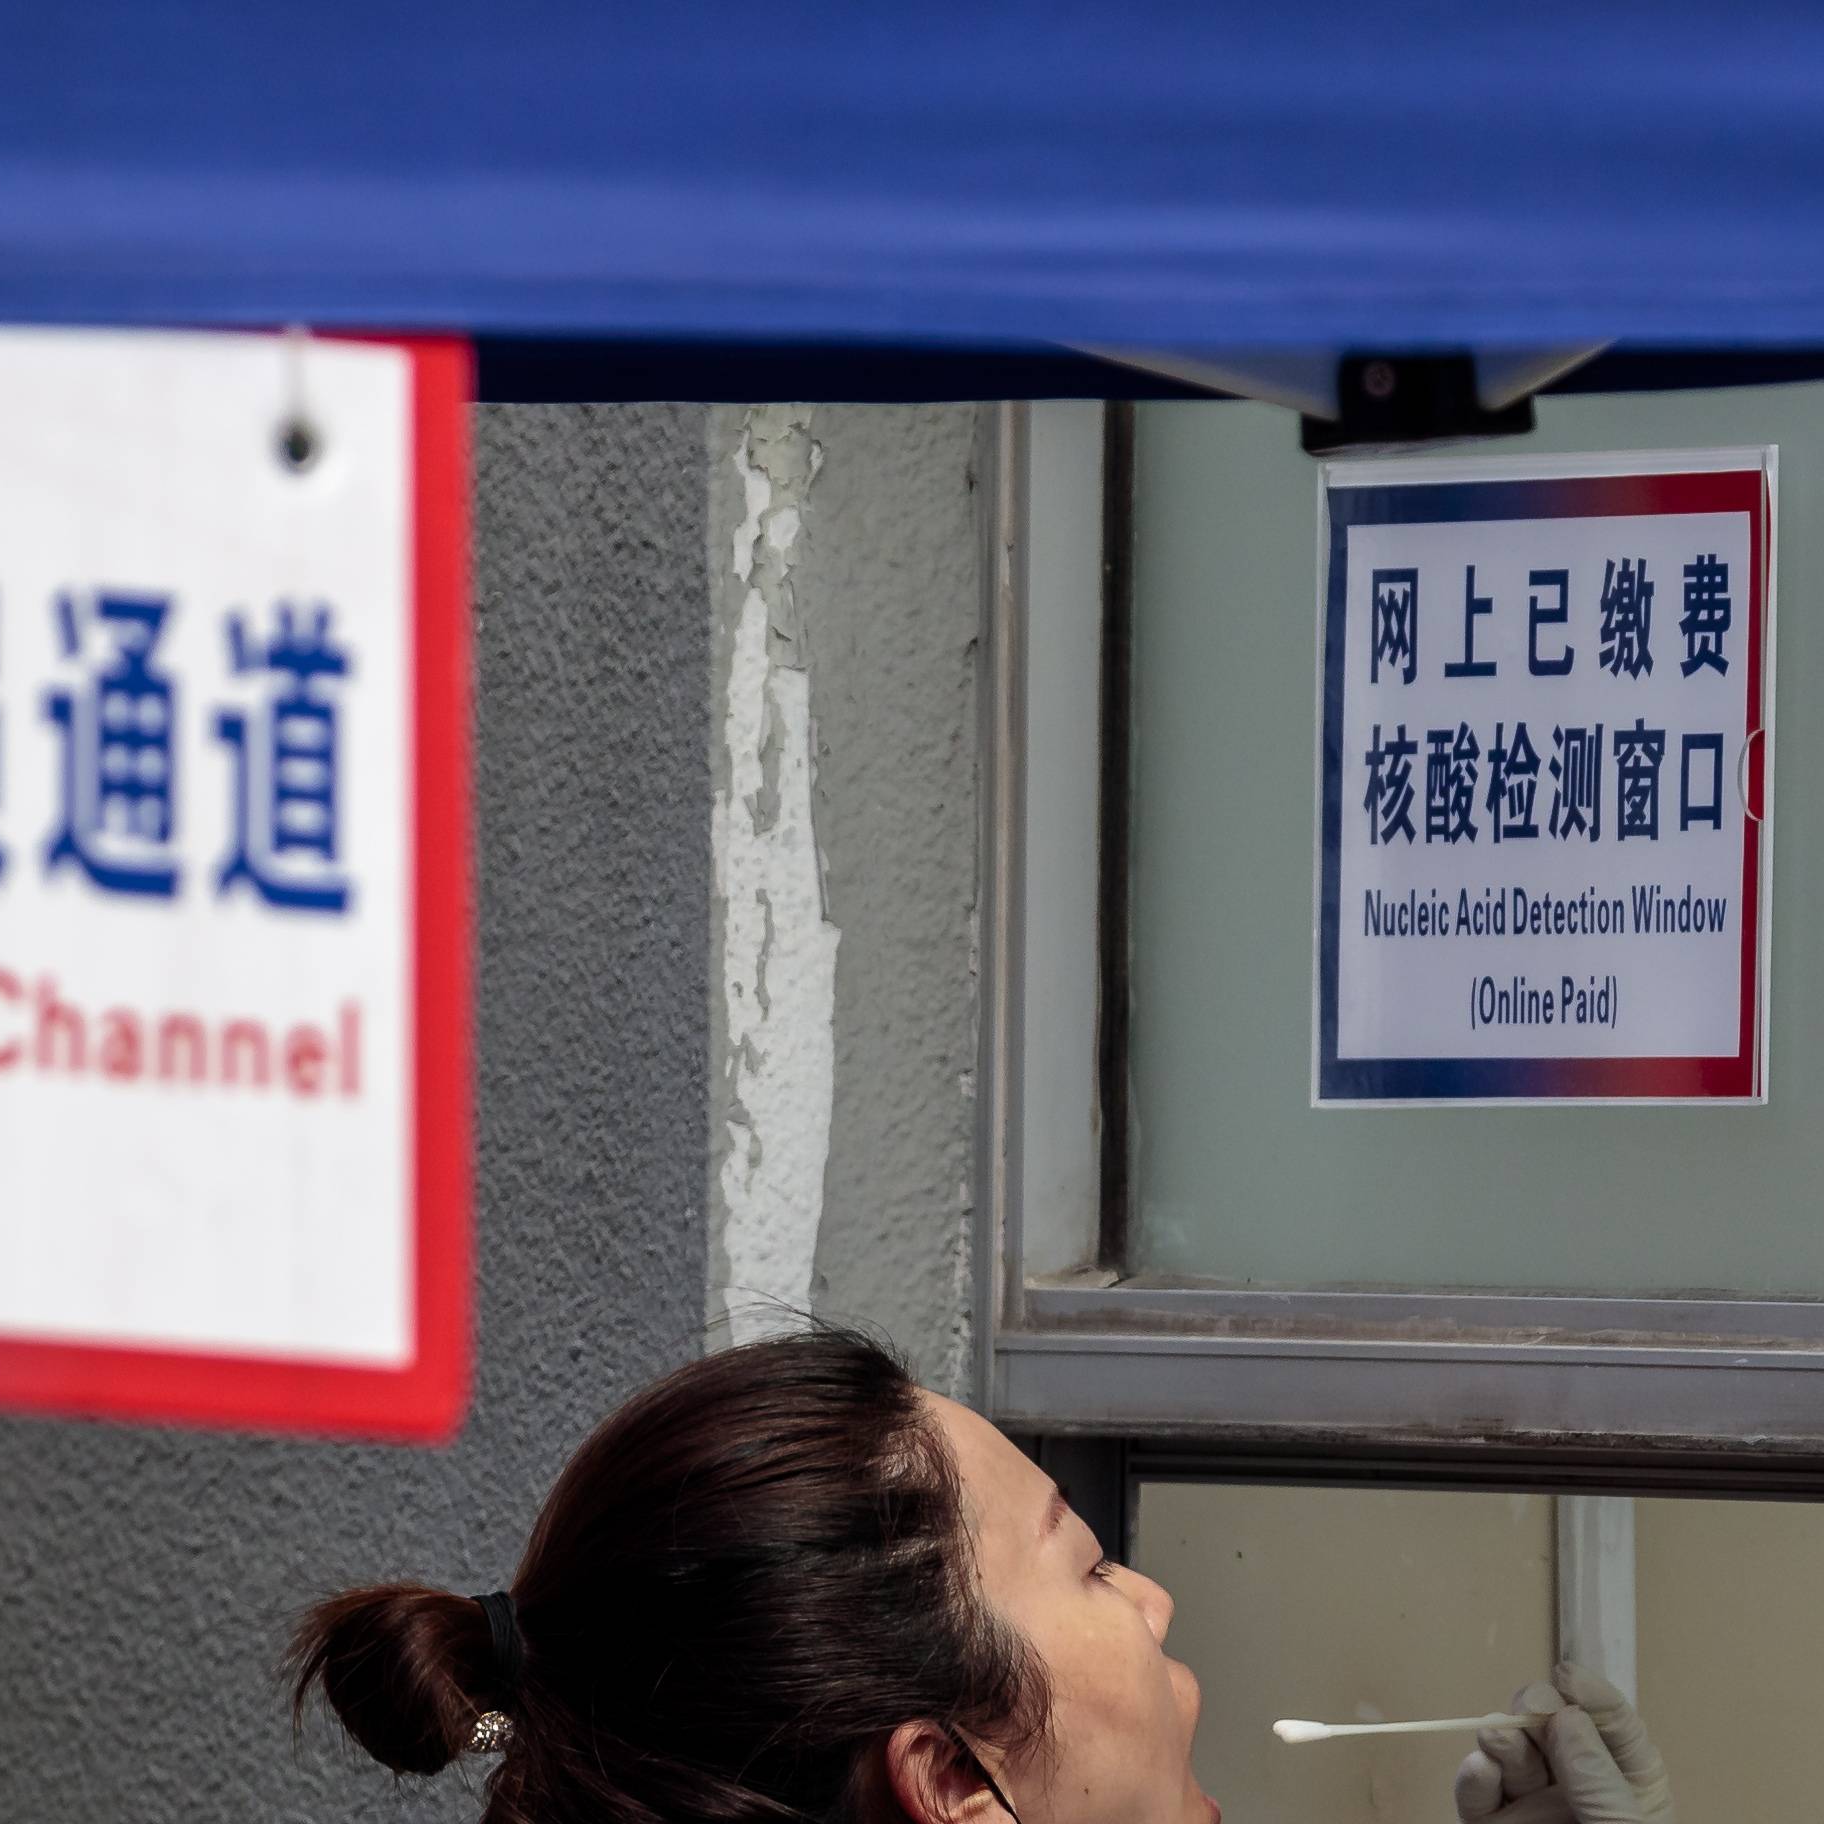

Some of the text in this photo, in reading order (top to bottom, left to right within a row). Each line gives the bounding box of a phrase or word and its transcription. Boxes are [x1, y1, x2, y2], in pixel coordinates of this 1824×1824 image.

[1370, 553, 1732, 685] 网上已缴费
[1364, 718, 1725, 846] 核酸检测窗口
[1364, 885, 1727, 936] Nucleic Acid Detection Window
[1470, 976, 1618, 1029] (Online Paid)
